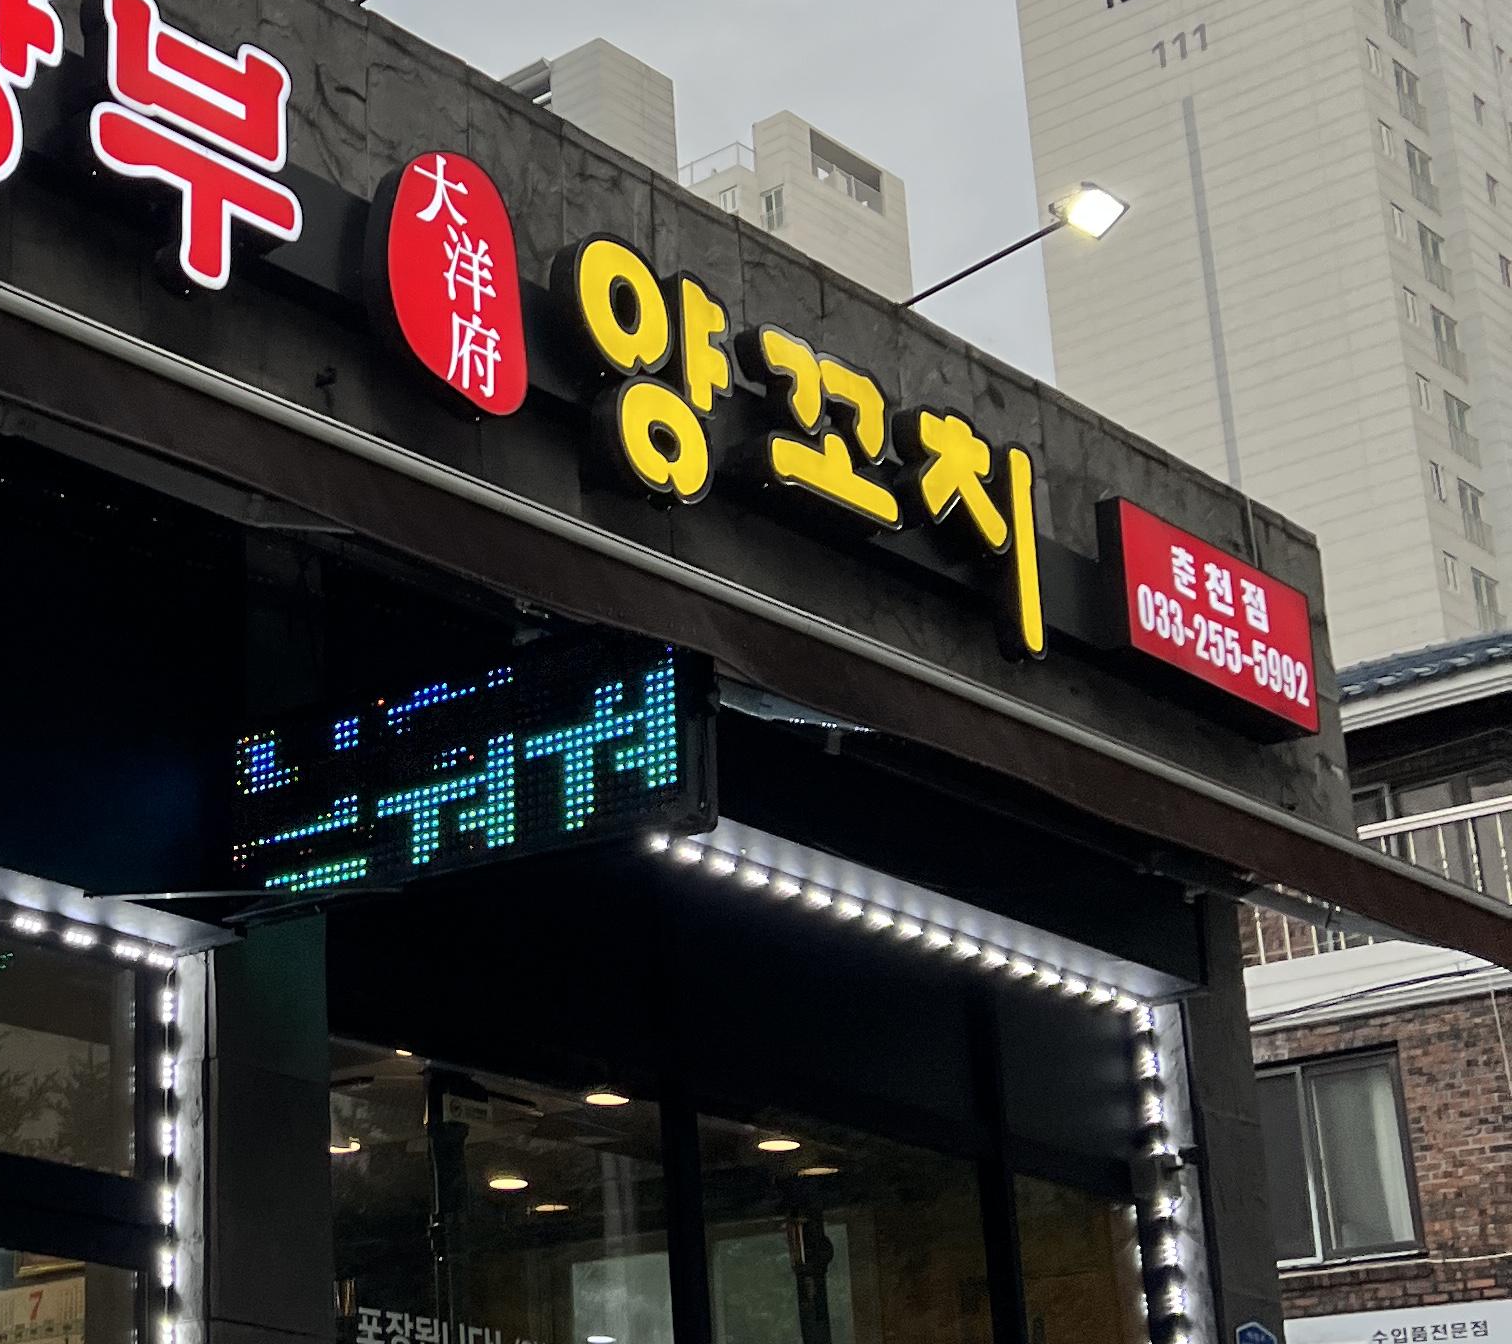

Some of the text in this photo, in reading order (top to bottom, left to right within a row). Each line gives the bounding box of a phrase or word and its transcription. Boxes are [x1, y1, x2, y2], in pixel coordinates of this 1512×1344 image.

[1151, 22, 1209, 69] 111
[412, 153, 503, 399] 大洋府
[576, 238, 1045, 656] 양꼬치
[1170, 544, 1270, 634] 춘천점
[1137, 583, 1311, 707] 033-255-5992
[28, 1290, 44, 1321] 7
